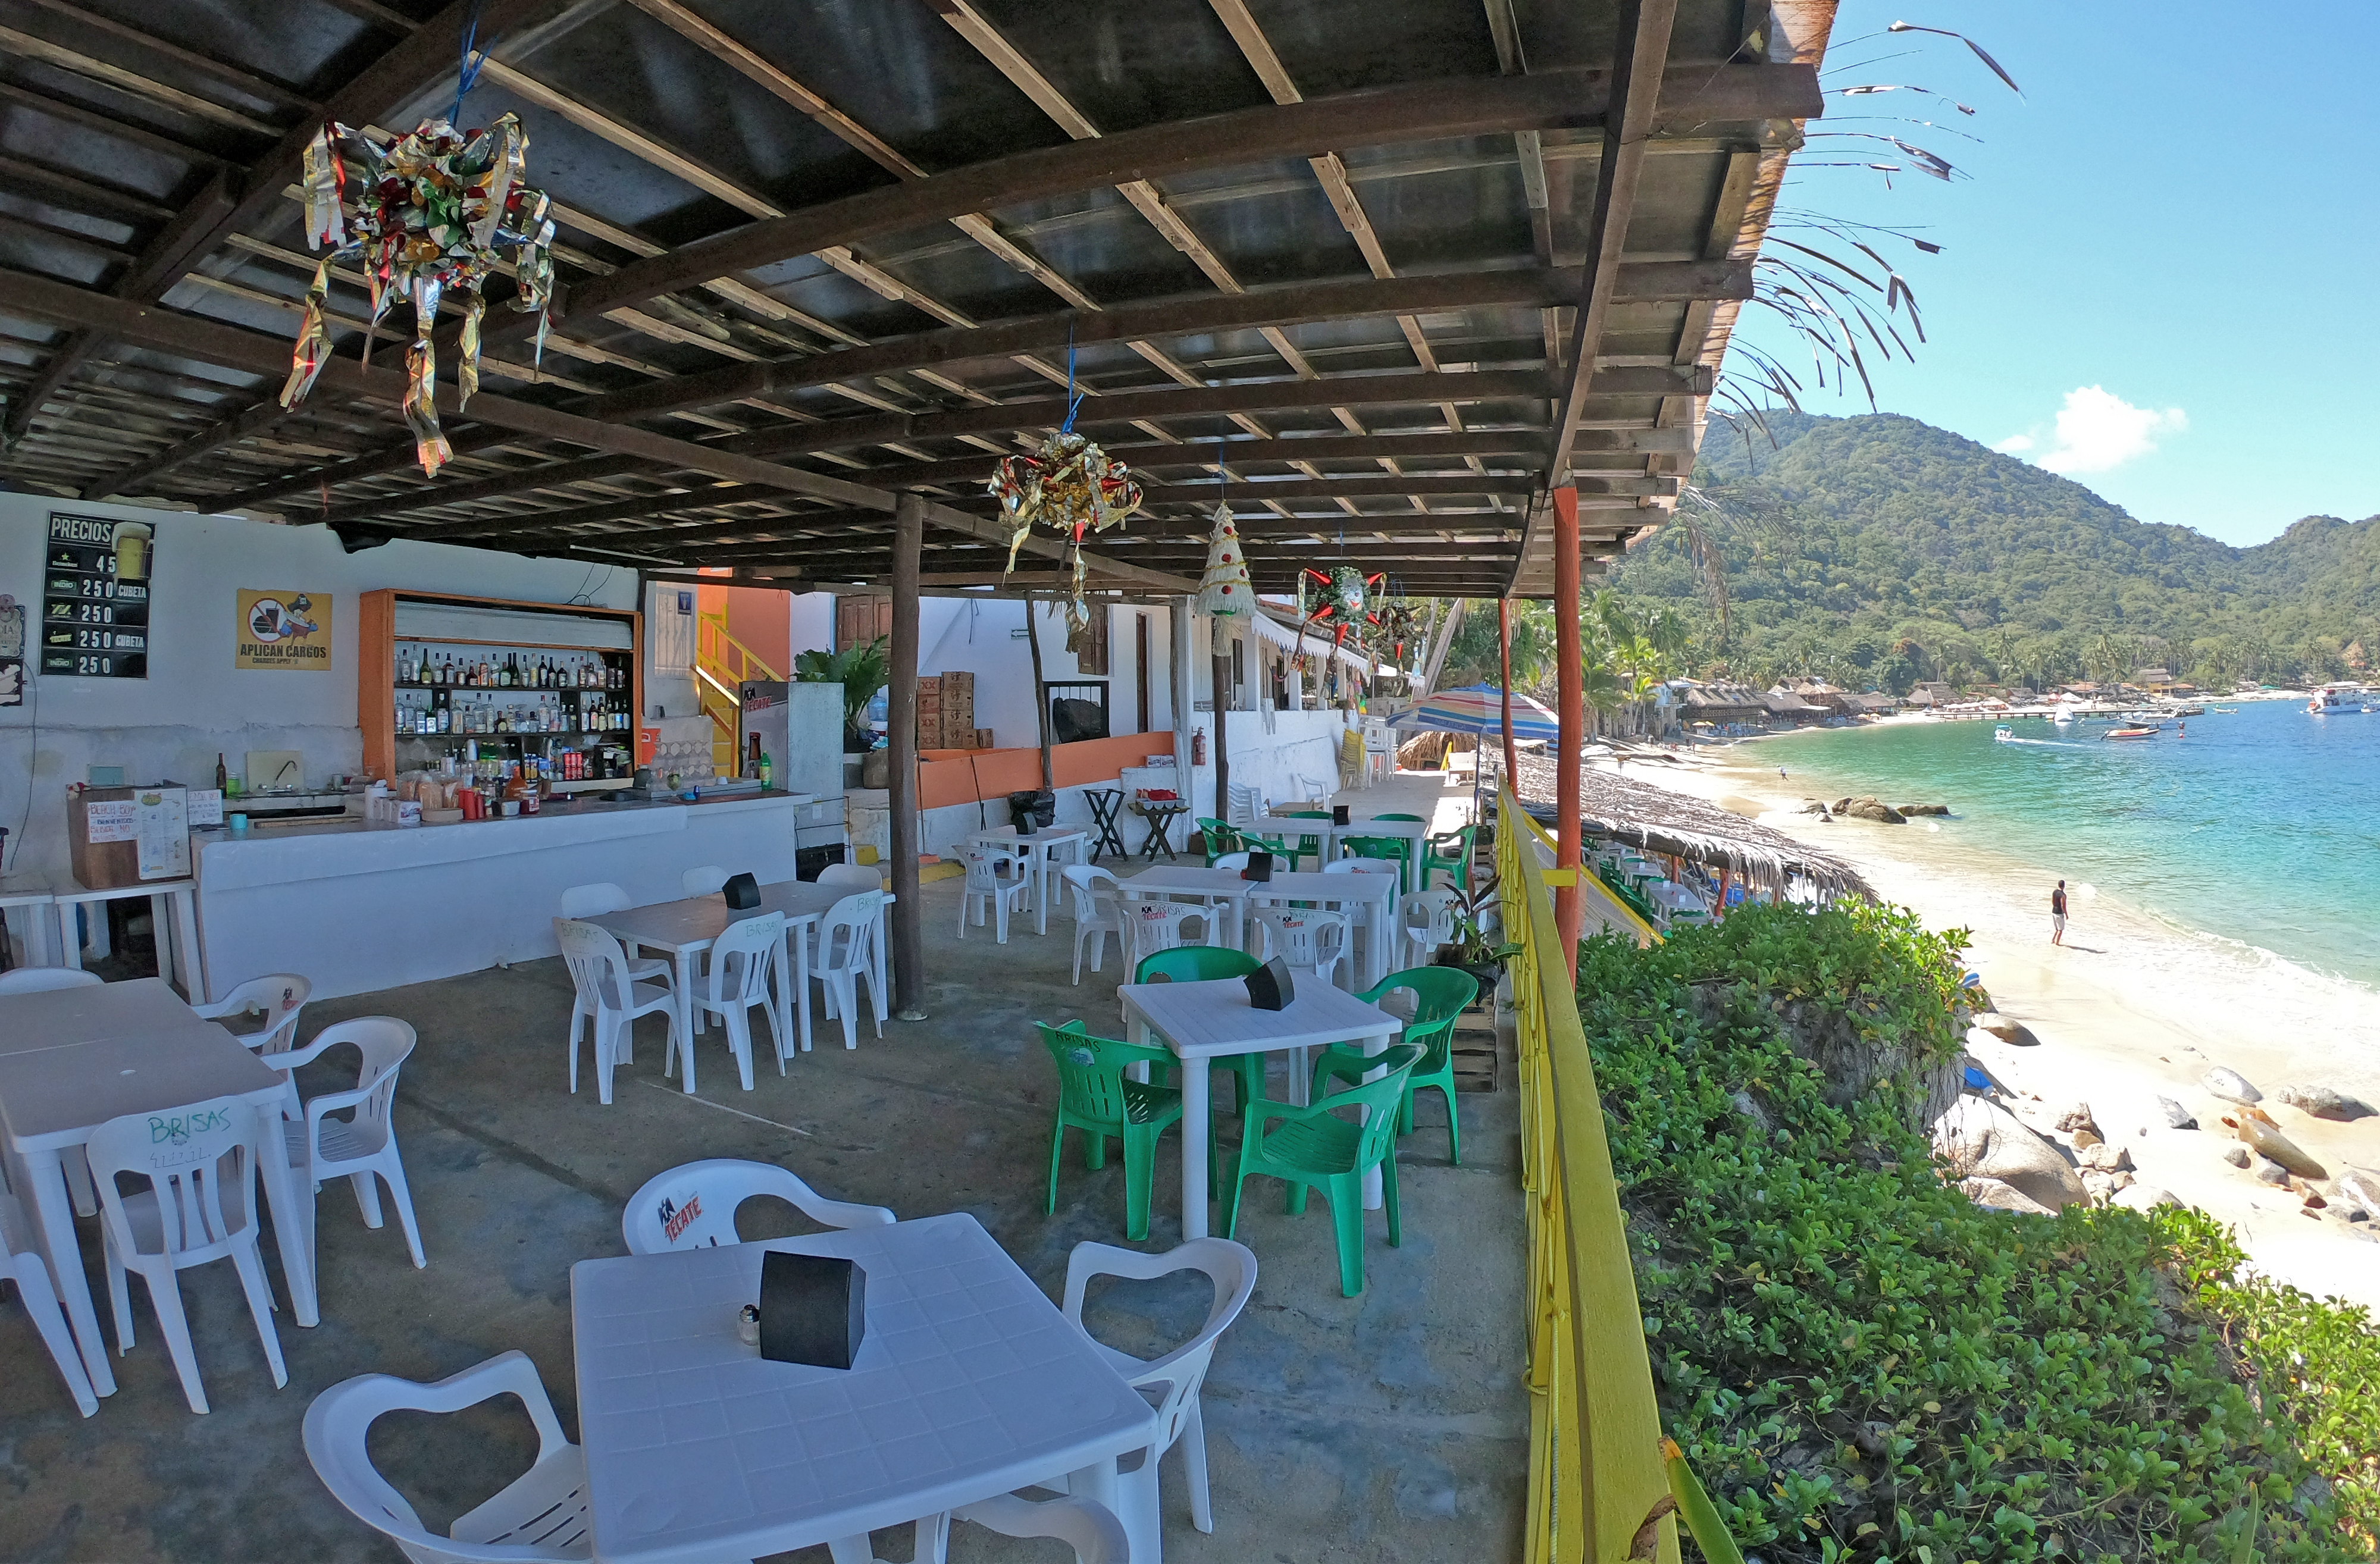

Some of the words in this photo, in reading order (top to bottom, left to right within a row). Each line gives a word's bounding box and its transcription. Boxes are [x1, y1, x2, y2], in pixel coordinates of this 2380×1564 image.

[51, 518, 111, 543] PRECIOS
[96, 555, 117, 573] 45
[83, 579, 114, 598] 250
[118, 585, 146, 598] CUBETA
[82, 604, 112, 623] 250
[80, 631, 111, 648] 250
[115, 634, 144, 648] CUBETA
[240, 644, 283, 657] APLICAN
[286, 645, 327, 659] CARGOS
[79, 656, 111, 674] 250
[744, 695, 772, 713] TECATE
[1434, 719, 1466, 731] NAUTICA
[90, 804, 115, 815] BEACH
[1142, 911, 1167, 921] TECATE
[1150, 902, 1187, 916] BRISAS
[746, 920, 778, 938] BRISAS
[1282, 920, 1305, 929] TECATE
[148, 1107, 231, 1144] BRISAS
[665, 1196, 702, 1246] TECATE
